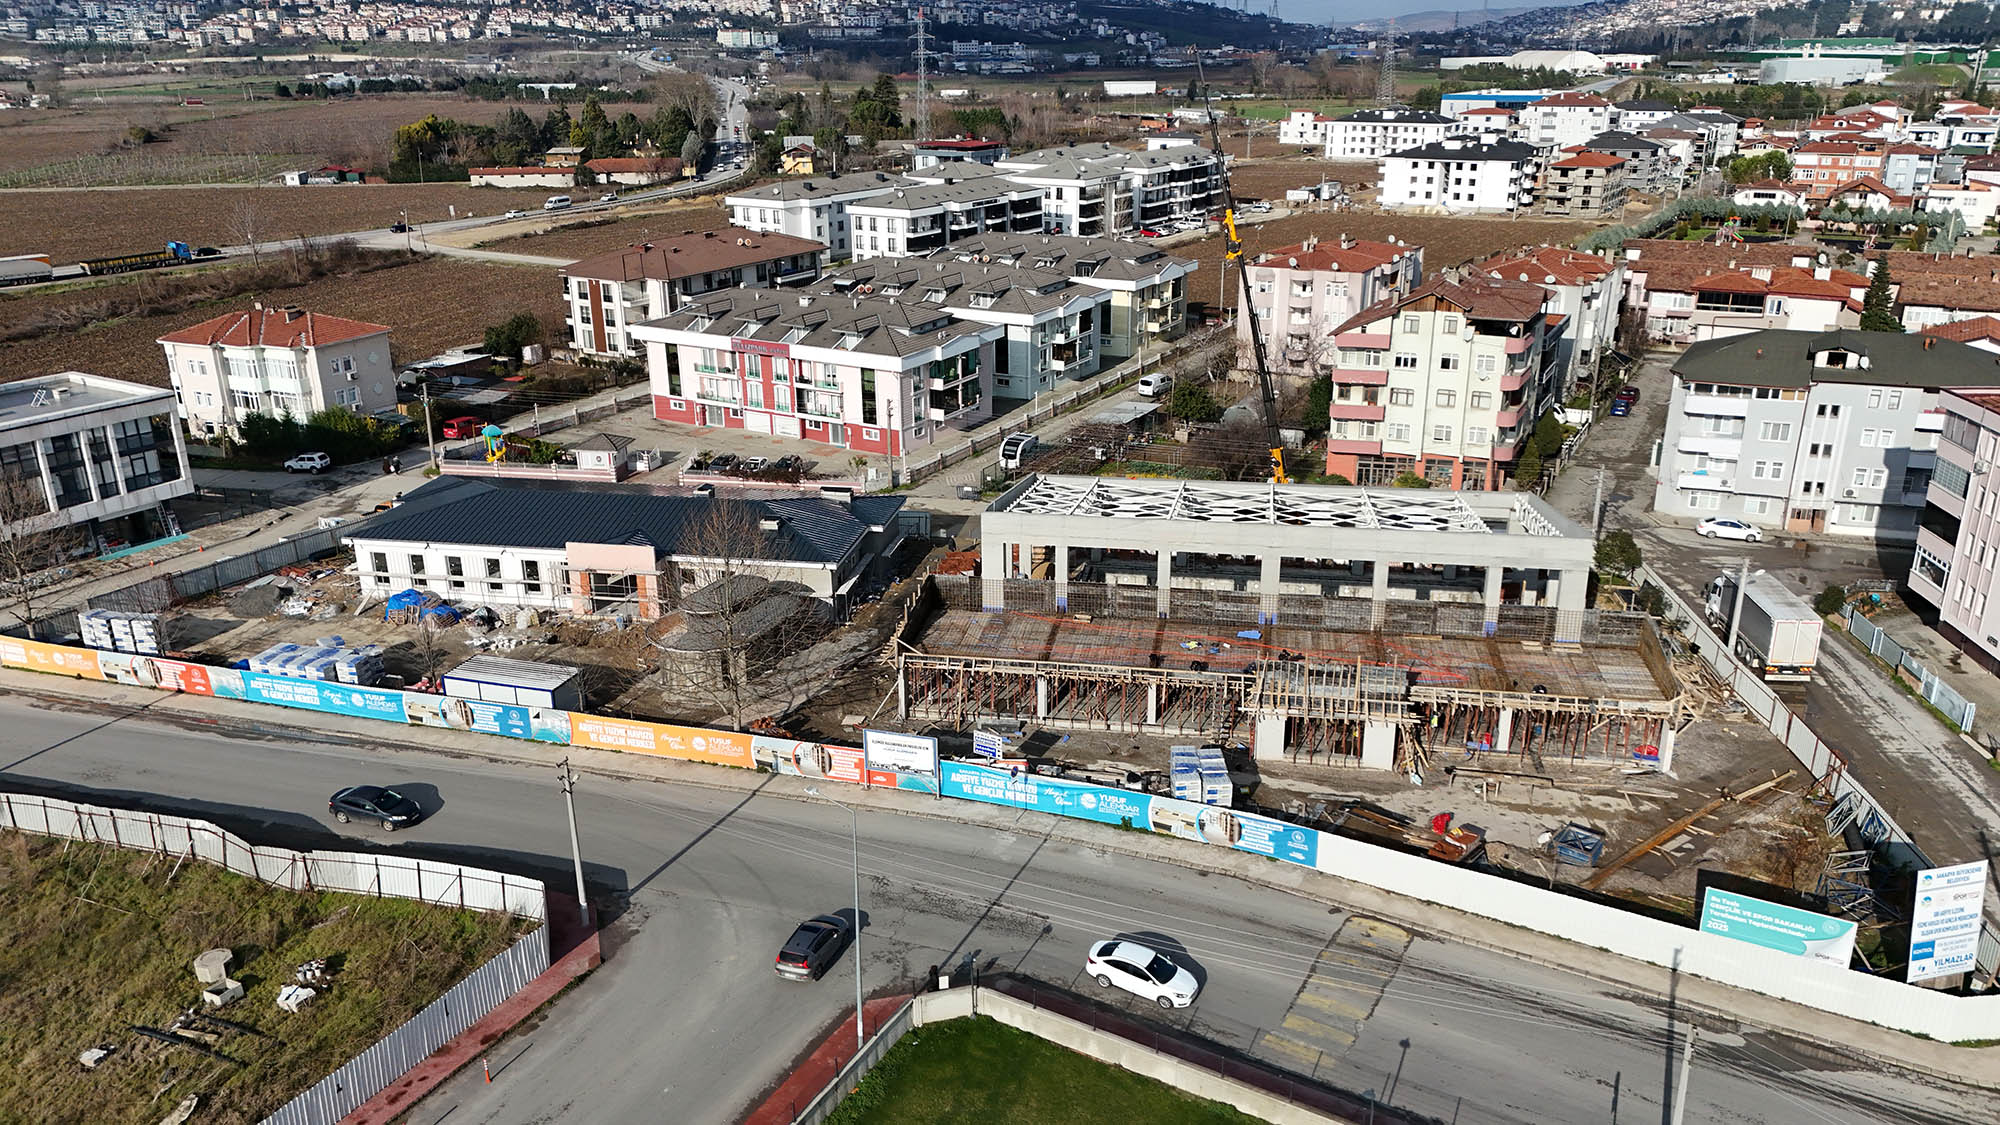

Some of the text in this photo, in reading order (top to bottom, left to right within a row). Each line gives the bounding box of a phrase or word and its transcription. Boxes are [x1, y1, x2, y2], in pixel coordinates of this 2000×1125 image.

[1099, 793, 1127, 804] YUSUF
[1099, 801, 1140, 812] ALEMDAR
[1743, 909, 1753, 917] VE
[1753, 912, 1774, 923] SPOR
[1706, 920, 1729, 932] 2025
[1934, 953, 1974, 967] YILMAZLAR
